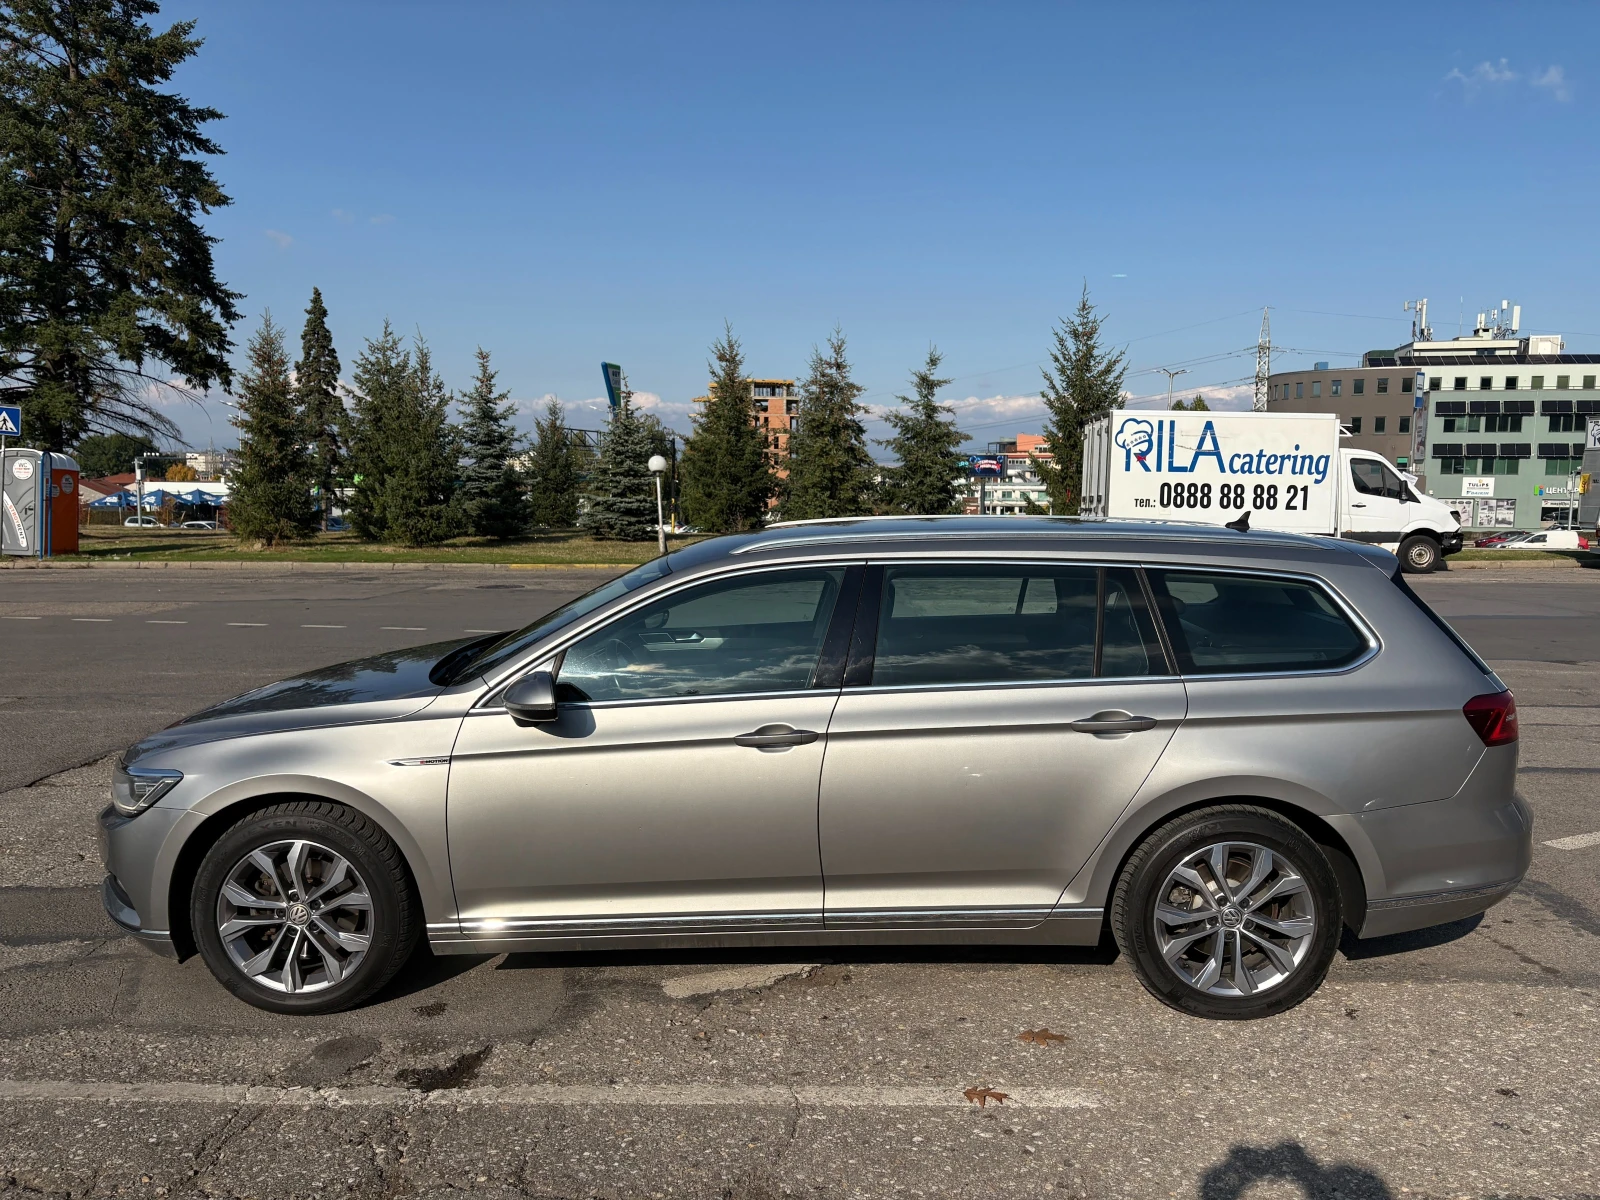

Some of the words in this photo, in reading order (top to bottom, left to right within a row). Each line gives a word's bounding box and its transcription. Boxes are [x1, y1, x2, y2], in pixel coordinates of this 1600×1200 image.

[1115, 418, 1226, 473] RILA
[1229, 444, 1331, 484] catering
[1134, 497, 1156, 508] тел.:
[1159, 482, 1212, 509] 0888
[1219, 483, 1245, 510] 88
[1252, 484, 1278, 510] 88
[1285, 484, 1309, 510] 21
[9, 504, 25, 540] STROYRENT
